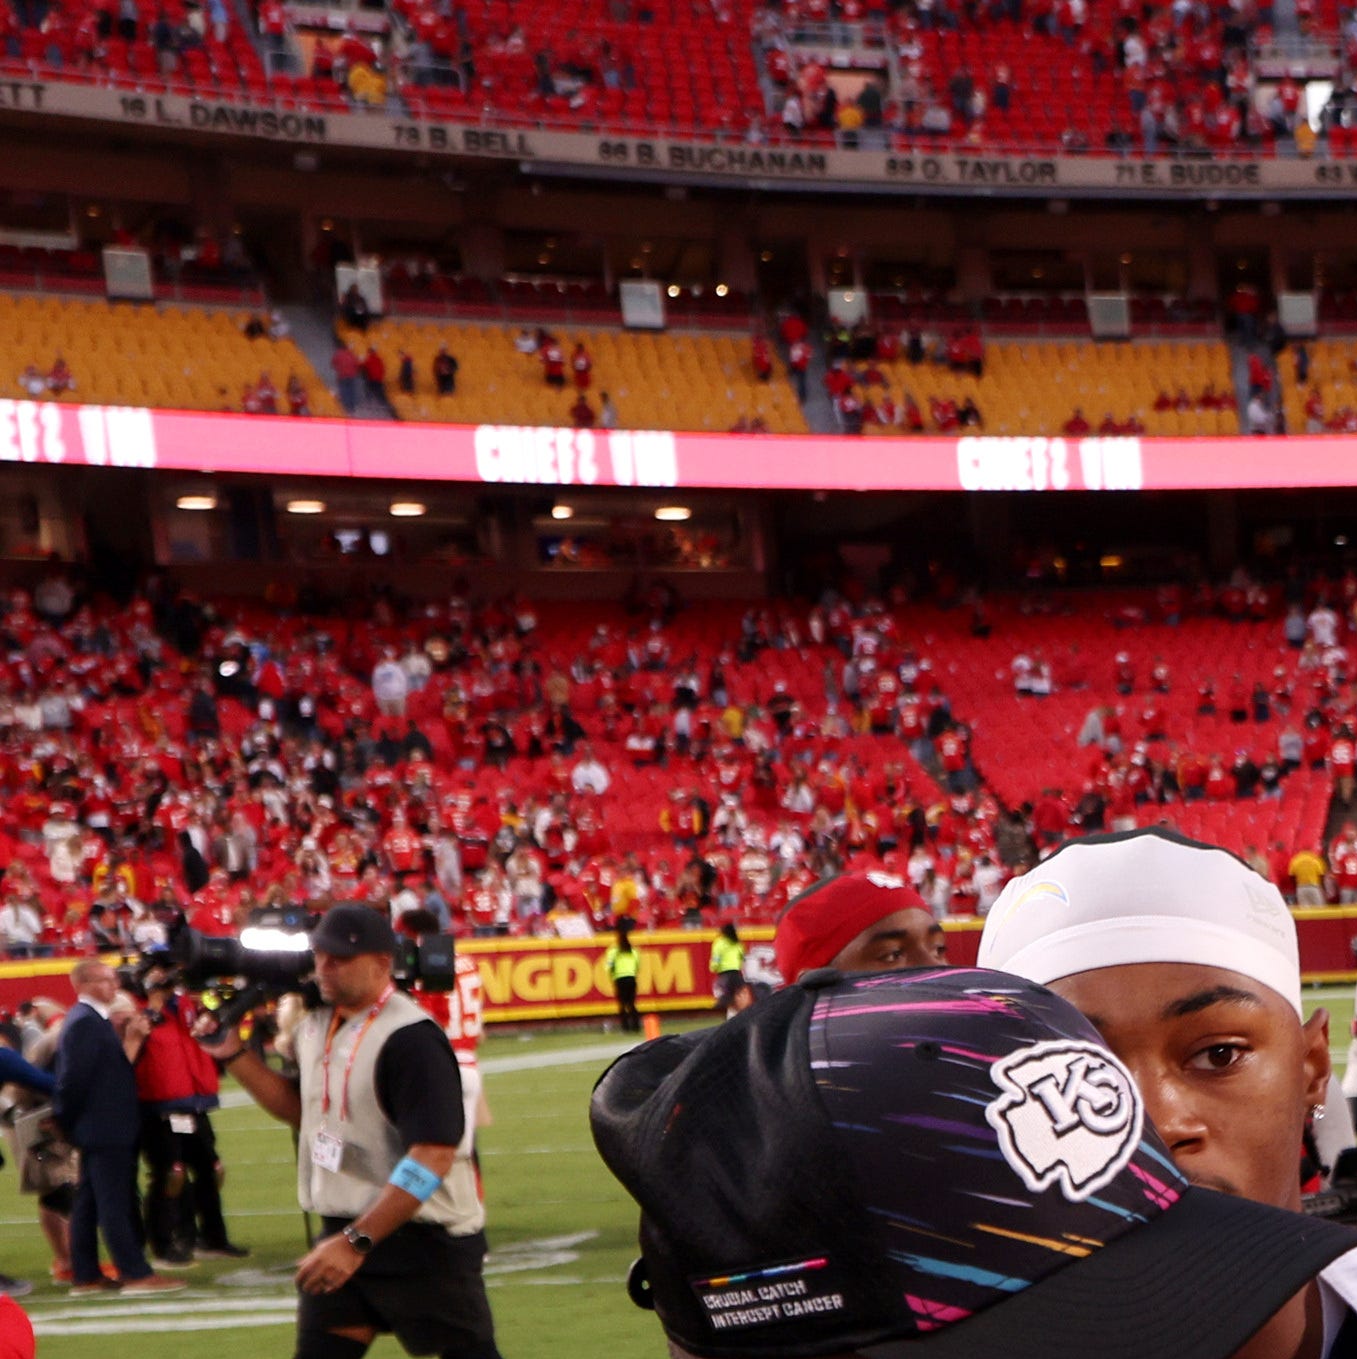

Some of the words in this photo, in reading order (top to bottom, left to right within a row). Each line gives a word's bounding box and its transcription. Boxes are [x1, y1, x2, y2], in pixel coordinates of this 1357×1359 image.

[190, 102, 326, 138] DAWSON
[461, 129, 536, 157] BELL
[667, 145, 827, 176] BUCHANAN
[955, 159, 1057, 184] TAYLOR
[1170, 163, 1260, 186] BUDDE
[703, 1289, 759, 1310] CRUCIAL
[757, 1280, 808, 1301] CATCH
[711, 1304, 783, 1329] INTERCEPT
[782, 1294, 844, 1318] CANCER
